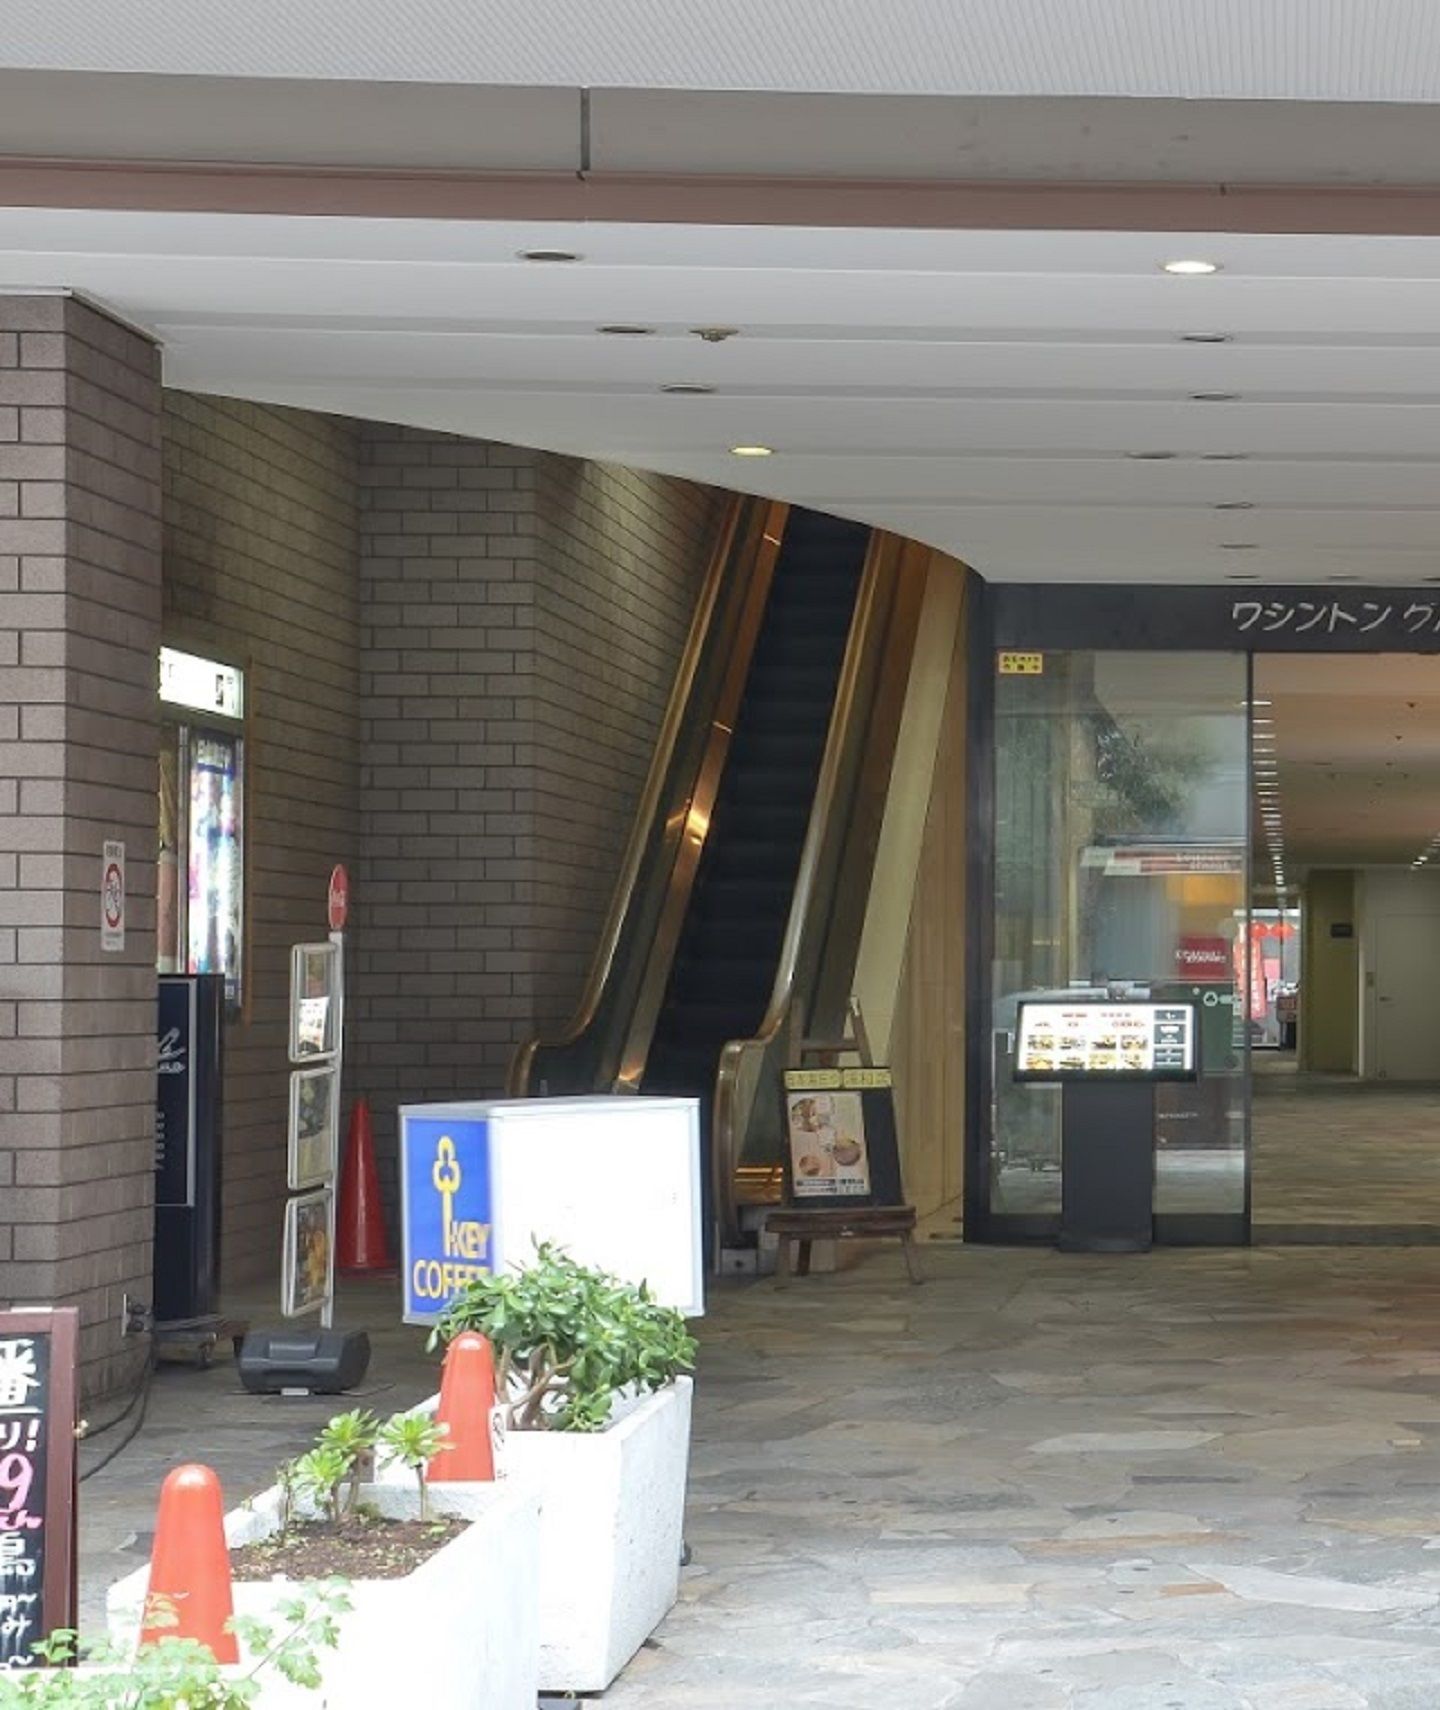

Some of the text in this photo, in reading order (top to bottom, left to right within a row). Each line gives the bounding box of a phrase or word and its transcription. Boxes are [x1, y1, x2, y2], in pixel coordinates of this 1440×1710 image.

[1232, 602, 1393, 633] ワシントン
[413, 1259, 491, 1299] COFF
